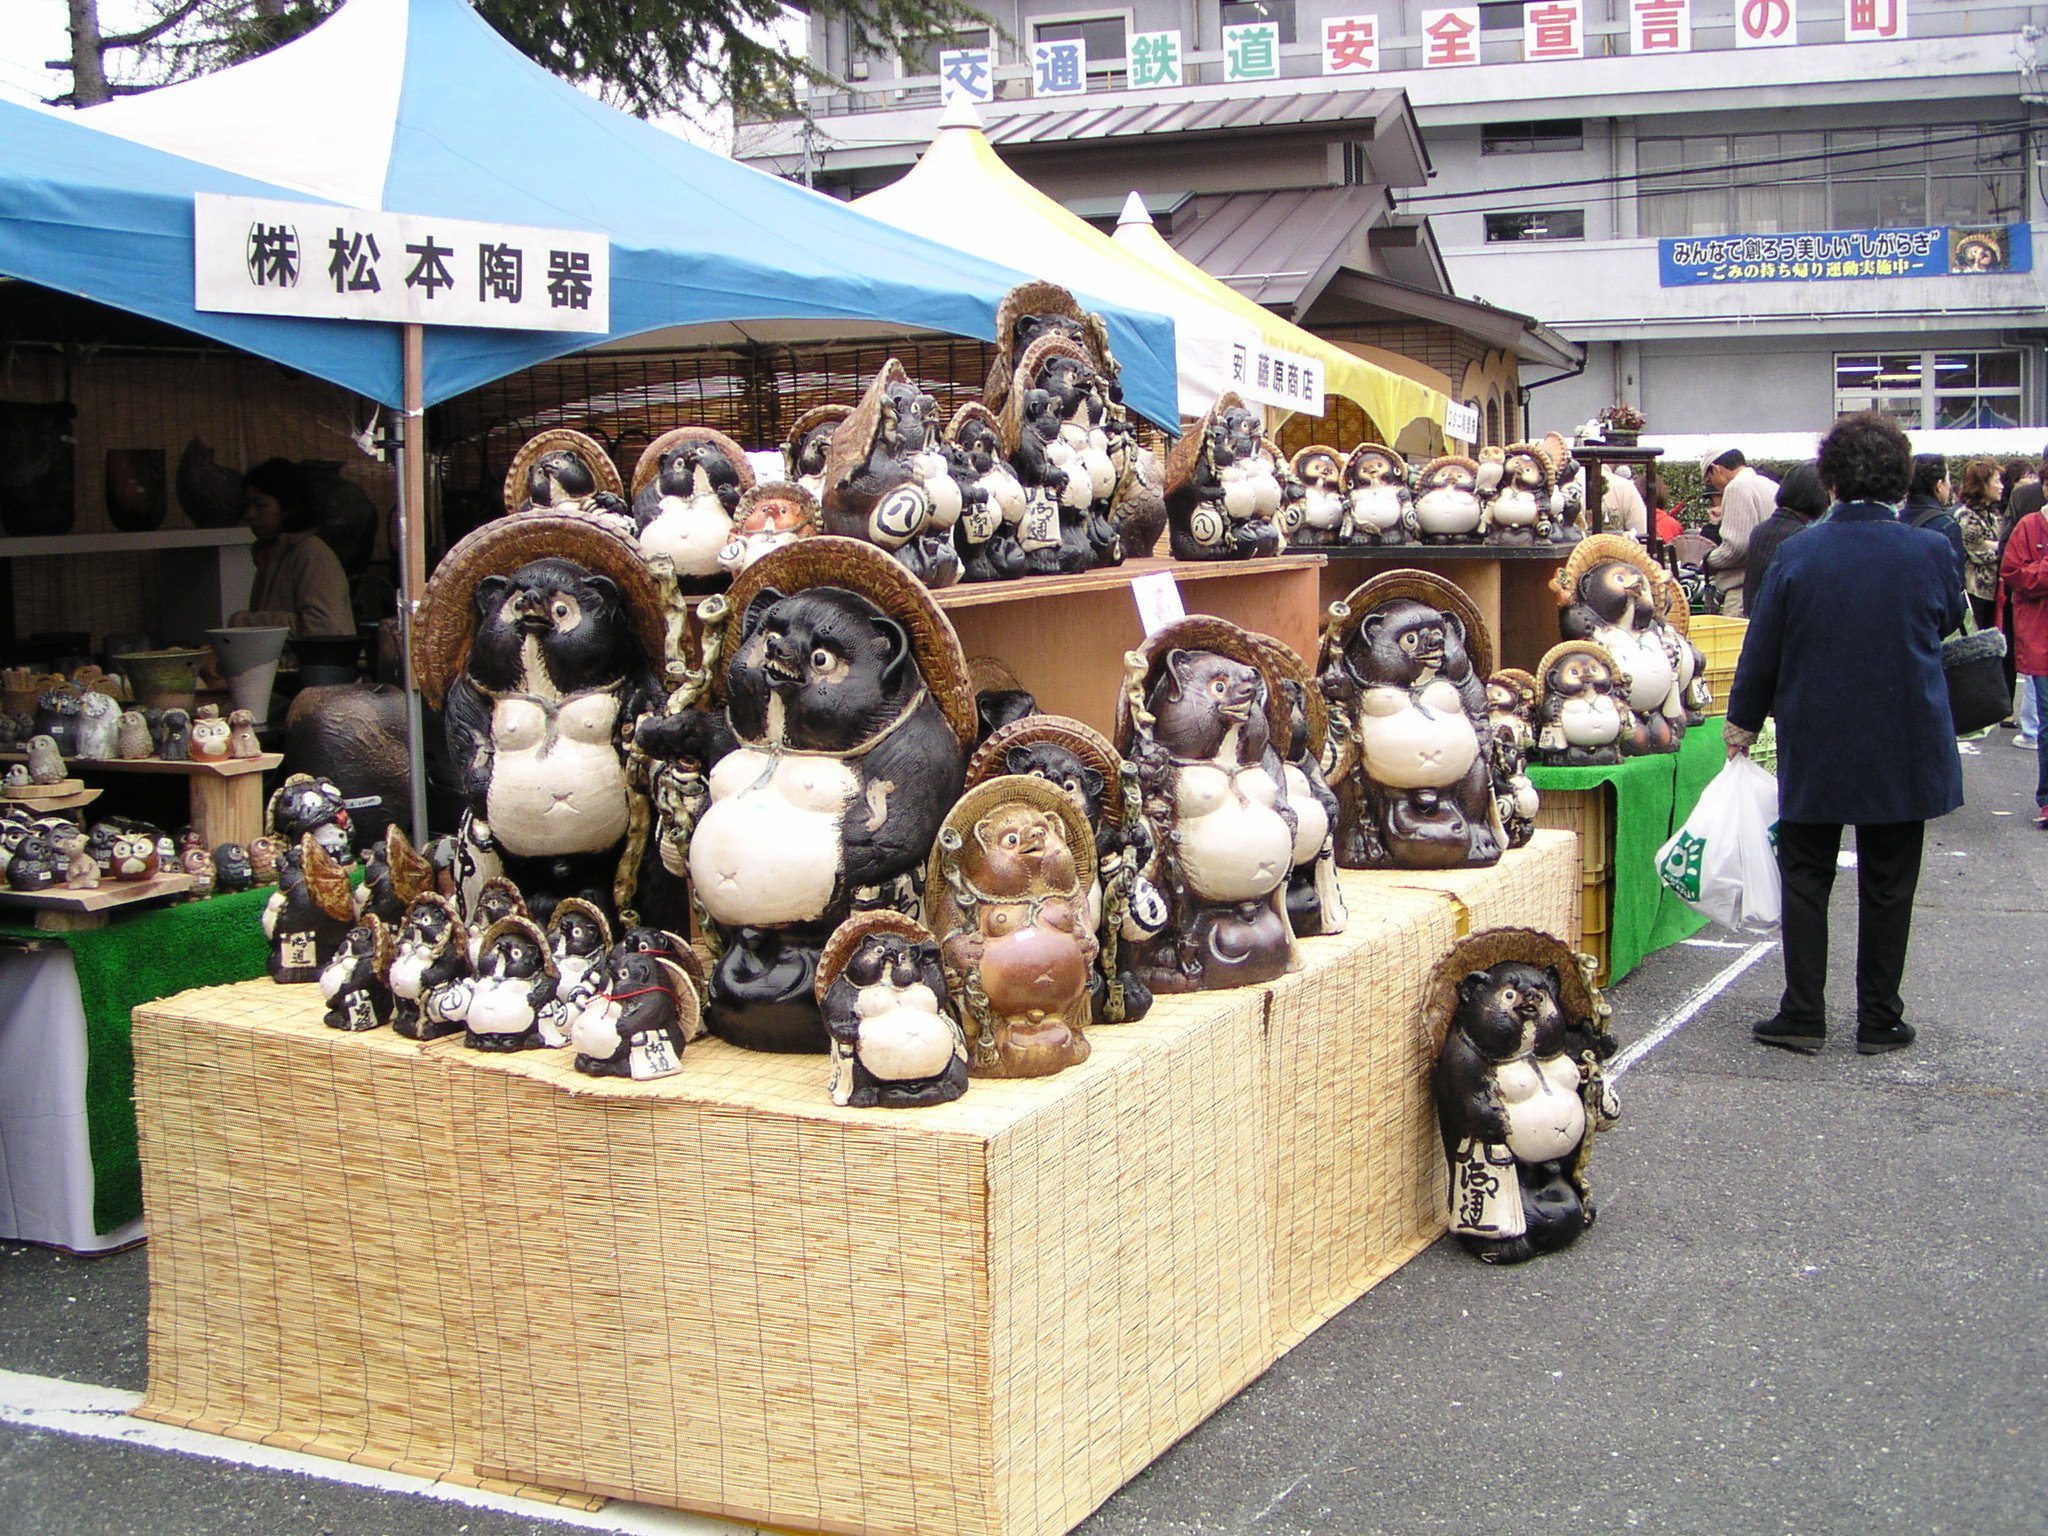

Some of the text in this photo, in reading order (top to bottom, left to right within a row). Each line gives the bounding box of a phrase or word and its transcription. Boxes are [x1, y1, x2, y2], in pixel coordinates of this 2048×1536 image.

[943, 0, 1898, 99] 交通鉄道安全宣言の町
